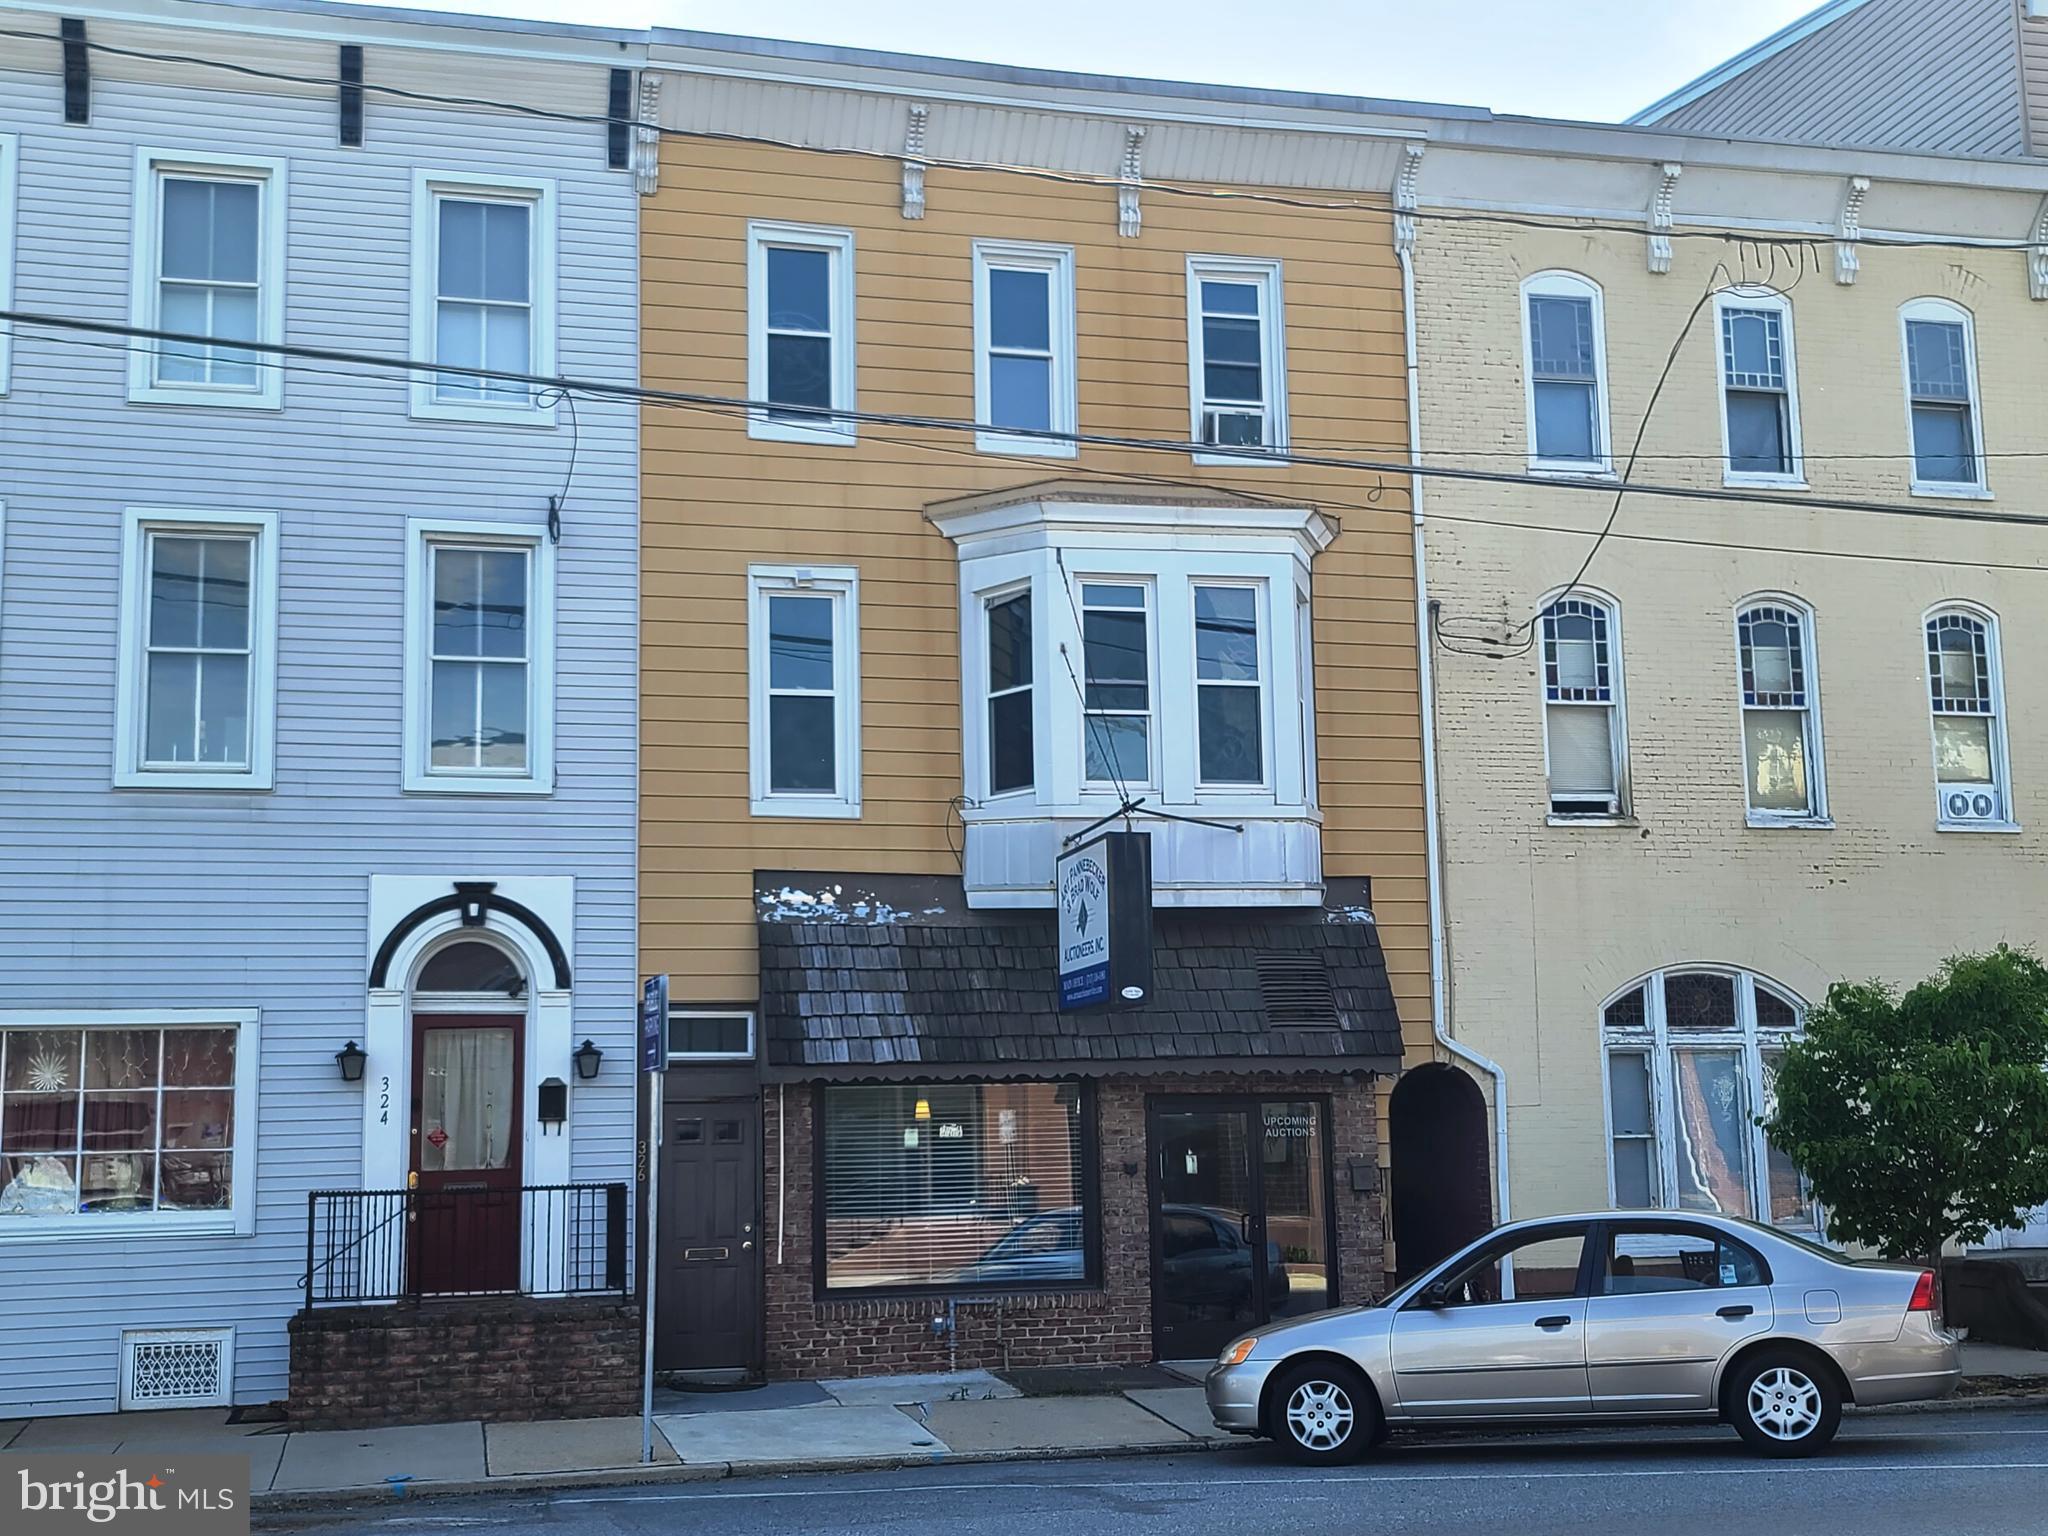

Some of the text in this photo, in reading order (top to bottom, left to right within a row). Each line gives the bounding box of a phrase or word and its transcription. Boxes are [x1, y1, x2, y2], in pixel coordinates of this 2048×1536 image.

[380, 1076, 390, 1126] 324
[1263, 1116, 1317, 1127] UPCOMING
[1265, 1127, 1317, 1138] AUCTIONS
[637, 1140, 646, 1182] 326
